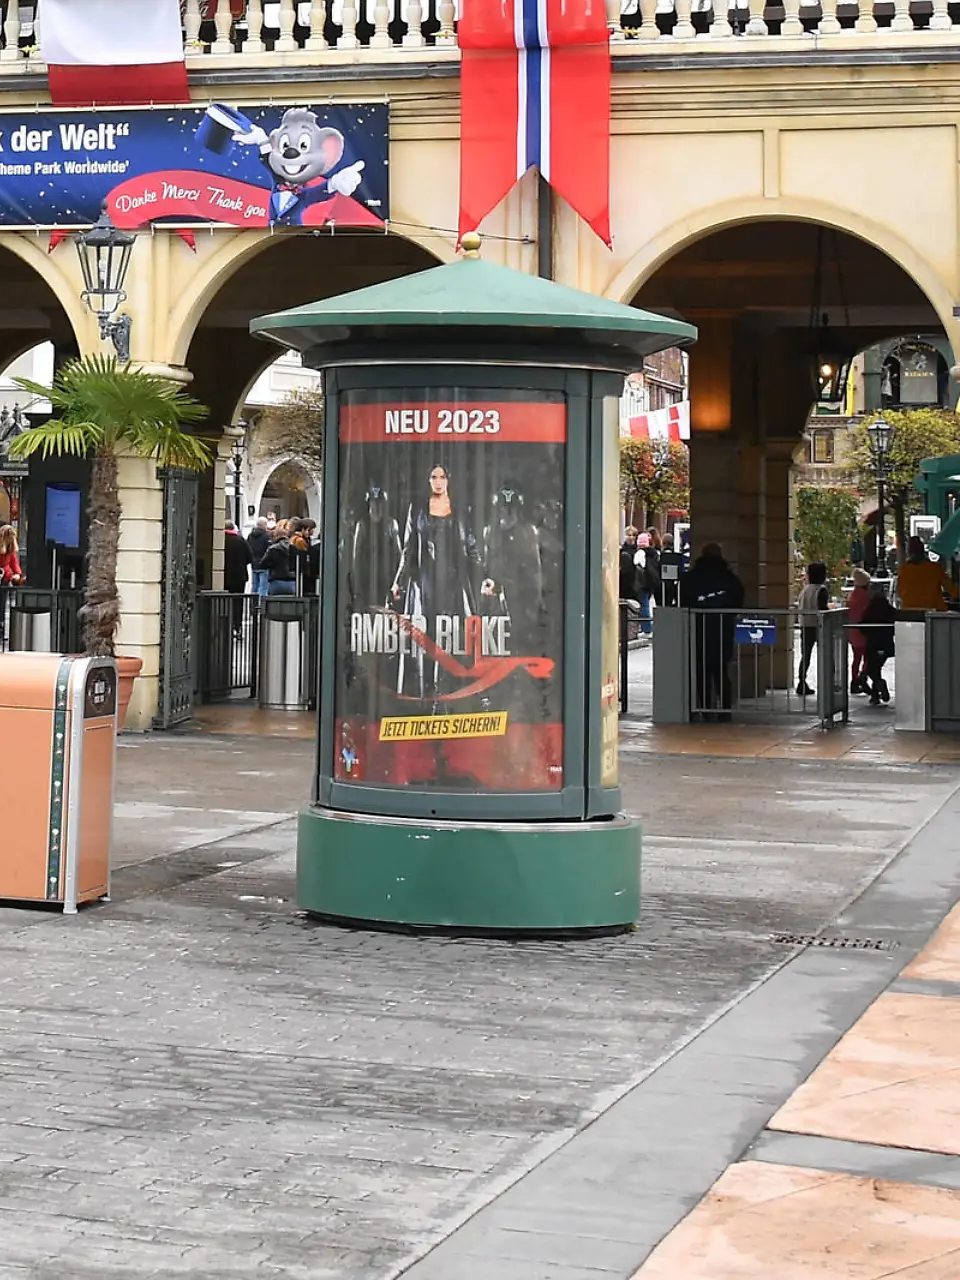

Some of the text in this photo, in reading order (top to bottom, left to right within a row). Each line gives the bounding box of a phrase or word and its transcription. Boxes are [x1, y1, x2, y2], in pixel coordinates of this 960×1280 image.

[11, 125, 52, 152] der
[34, 161, 61, 174] Park
[115, 181, 267, 218] Danke Merci Thank you
[385, 409, 500, 434] NEU 2023
[350, 612, 512, 658] AMBER BLAKE
[382, 717, 501, 737] JETZT TICKETS SICHERN!
